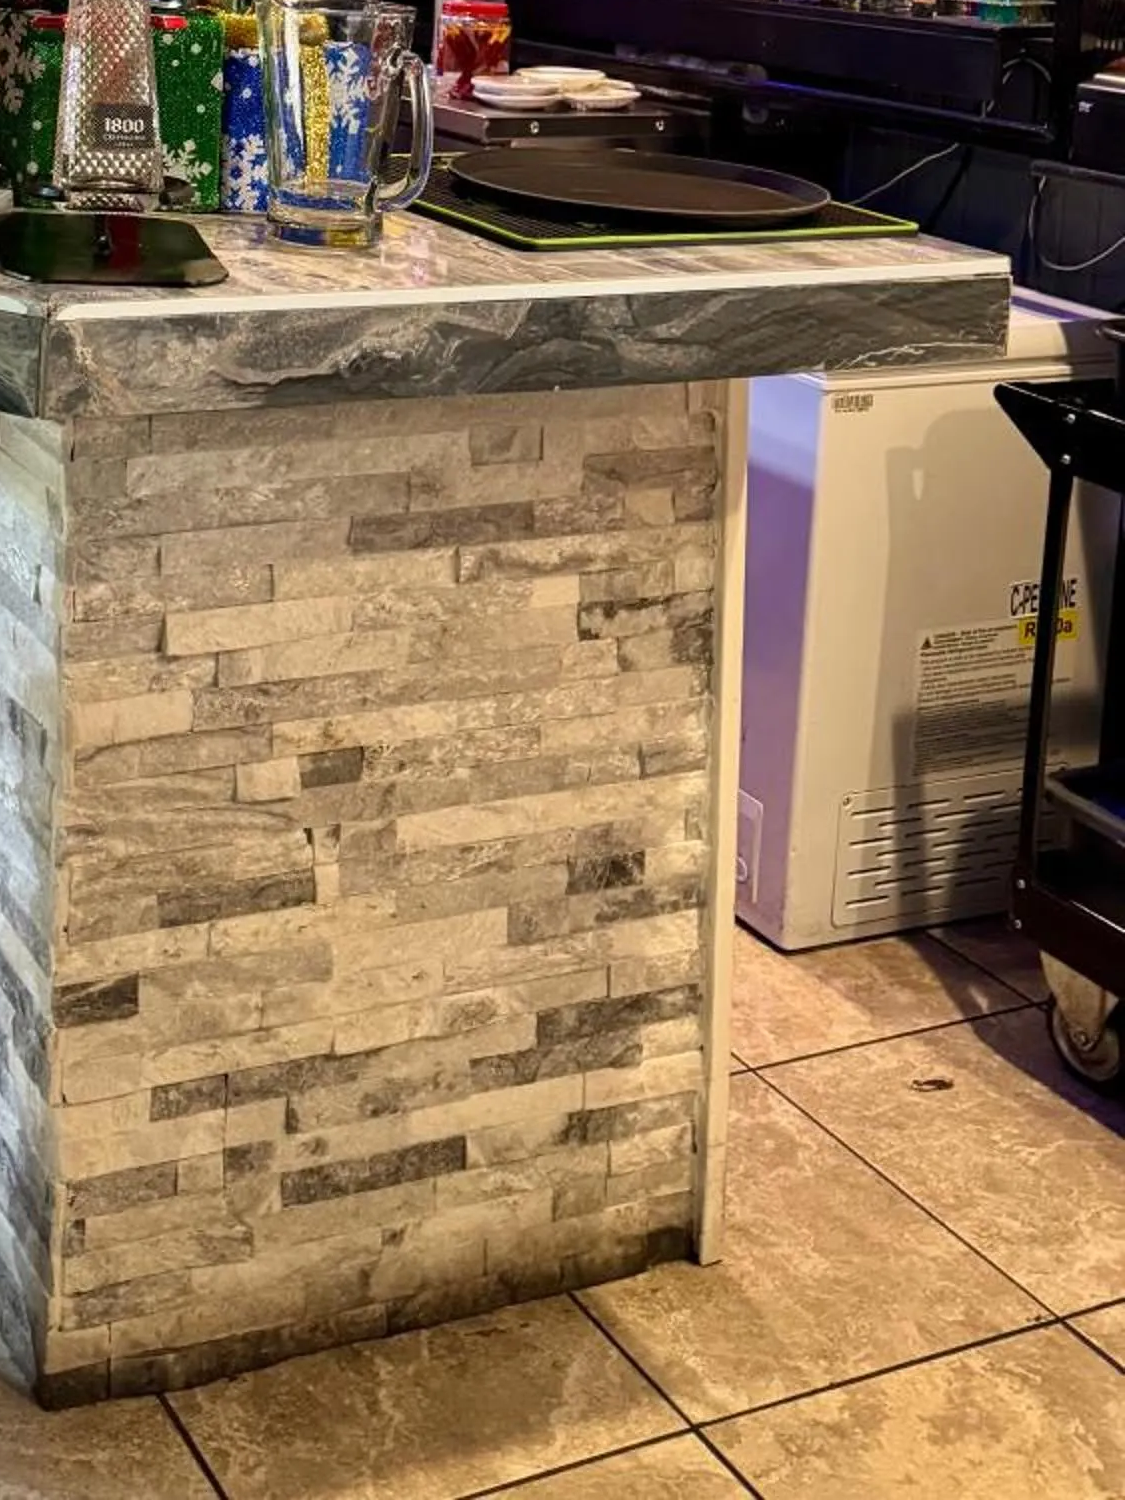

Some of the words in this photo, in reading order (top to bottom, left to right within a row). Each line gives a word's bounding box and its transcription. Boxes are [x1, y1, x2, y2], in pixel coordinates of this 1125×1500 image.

[104, 116, 145, 134] 1800
[1010, 578, 1078, 617] C-PENE
[1024, 616, 1073, 639] R0a
